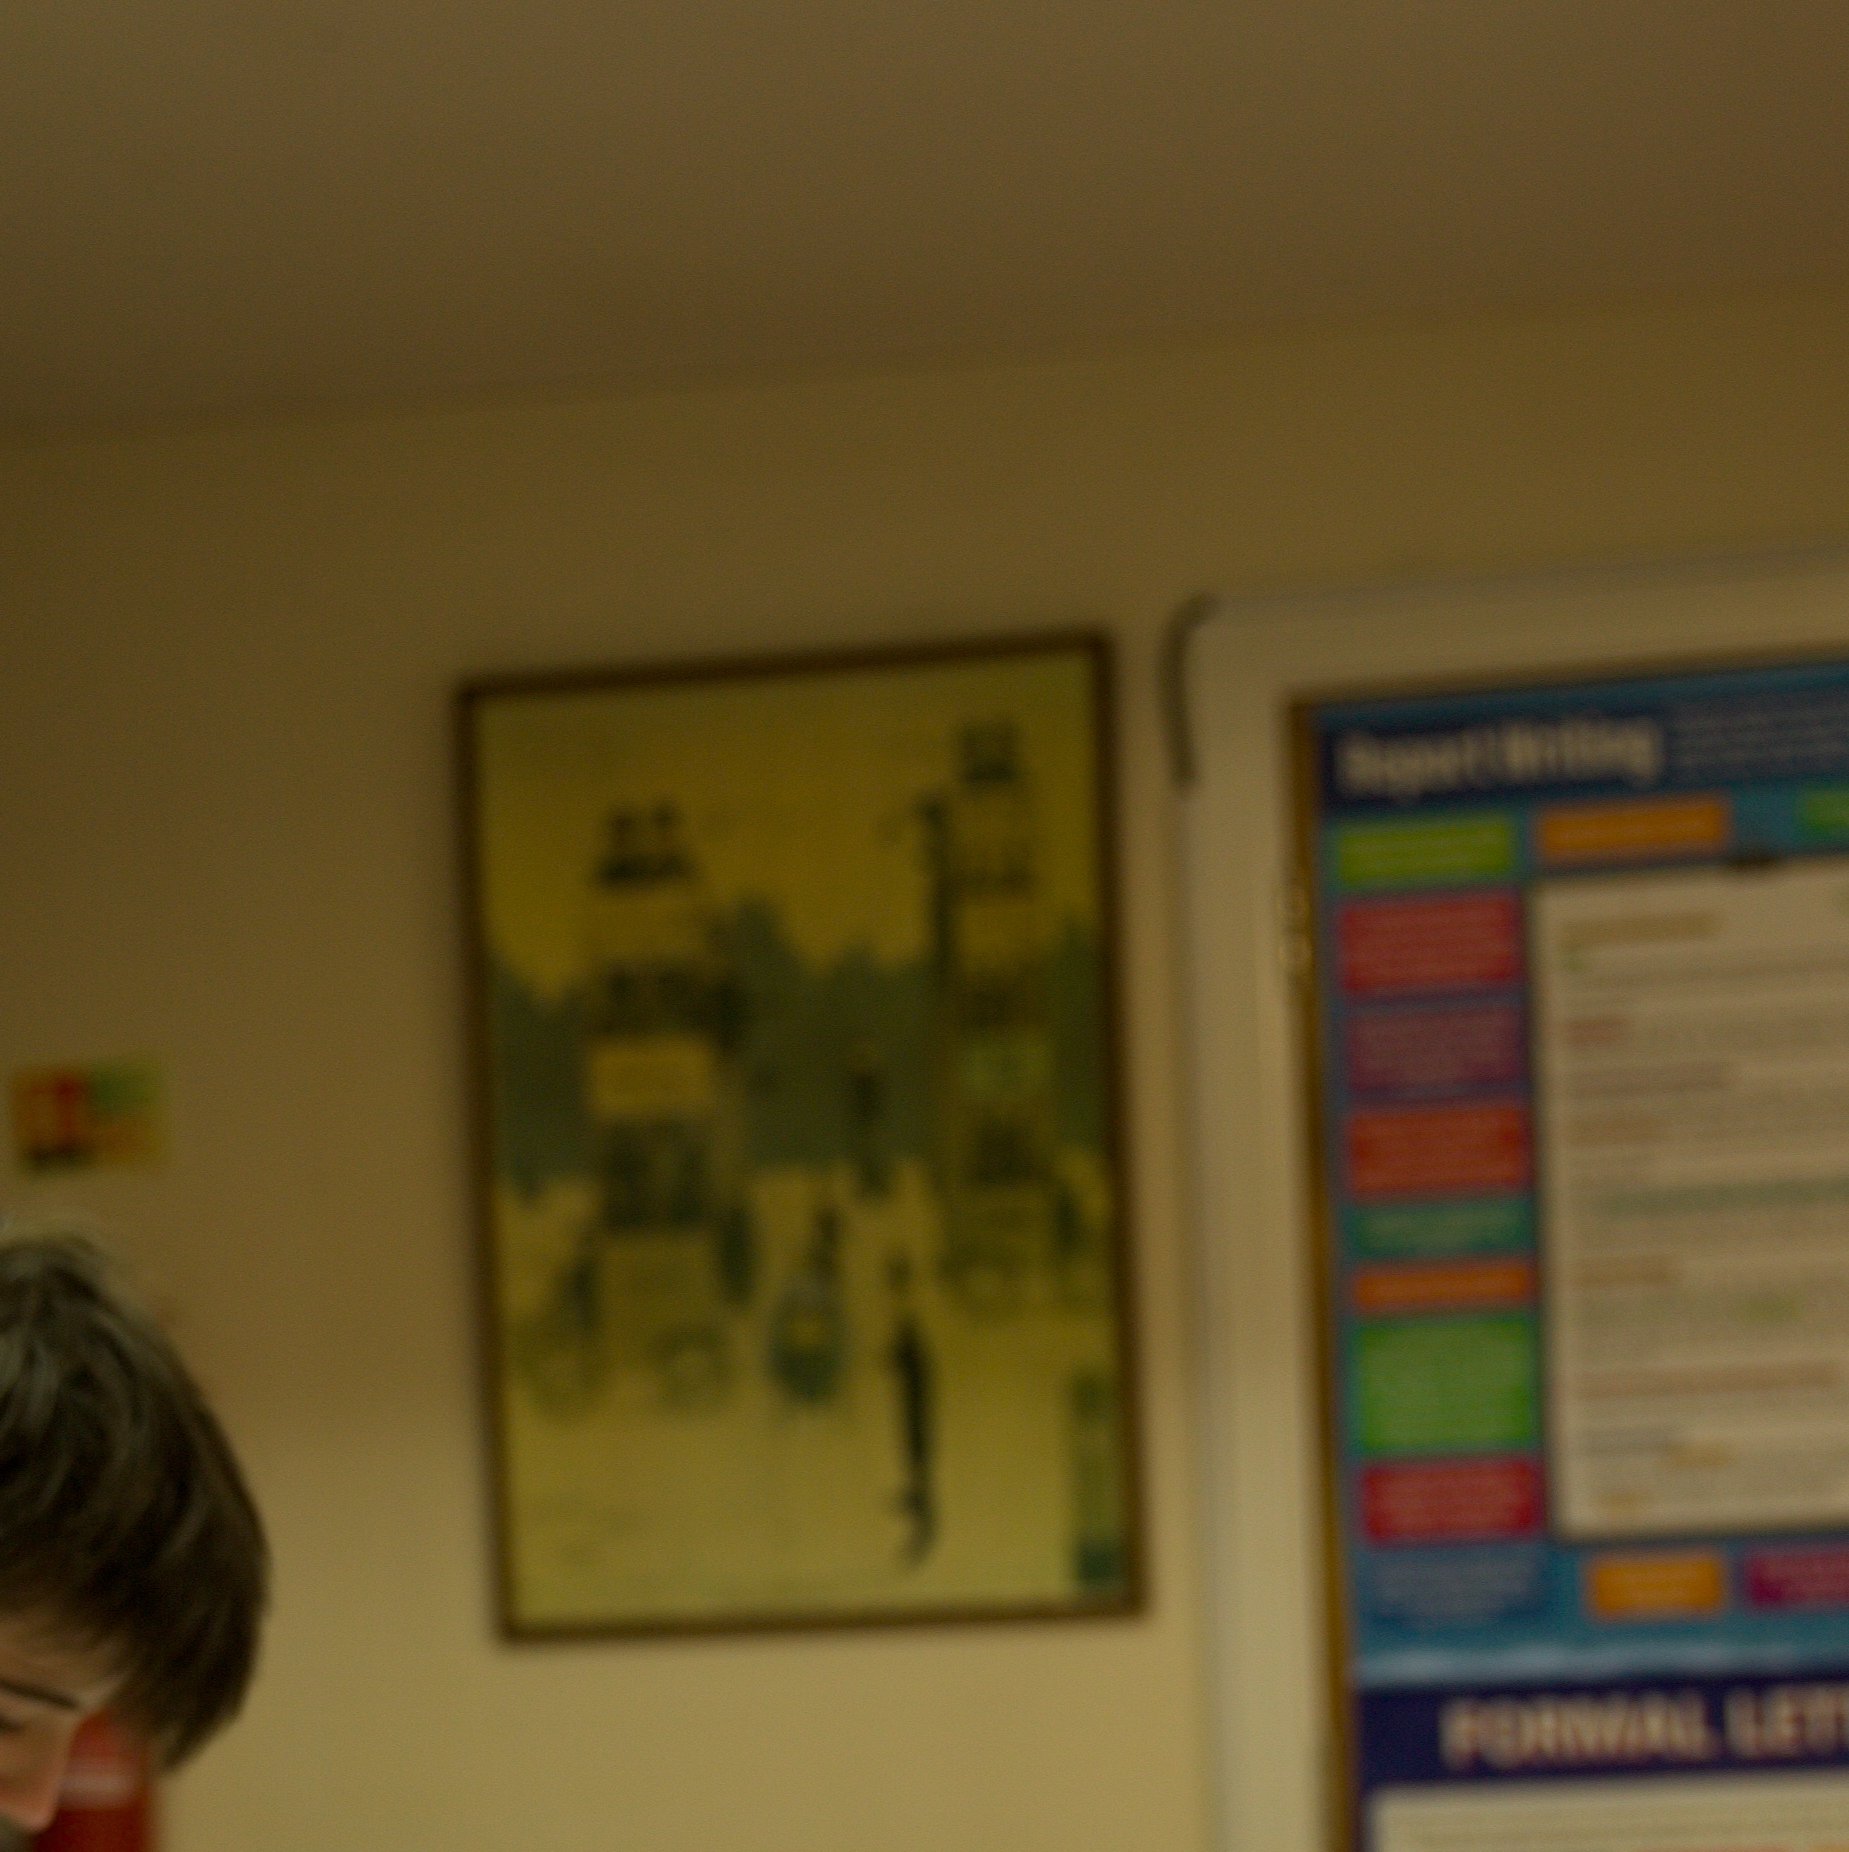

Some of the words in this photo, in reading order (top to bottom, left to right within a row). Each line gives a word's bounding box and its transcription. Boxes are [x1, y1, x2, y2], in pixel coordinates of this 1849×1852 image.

[1336, 727, 1478, 800] Report
[1493, 712, 1663, 786] Writing
[1439, 1690, 1720, 1768] FORMAL
